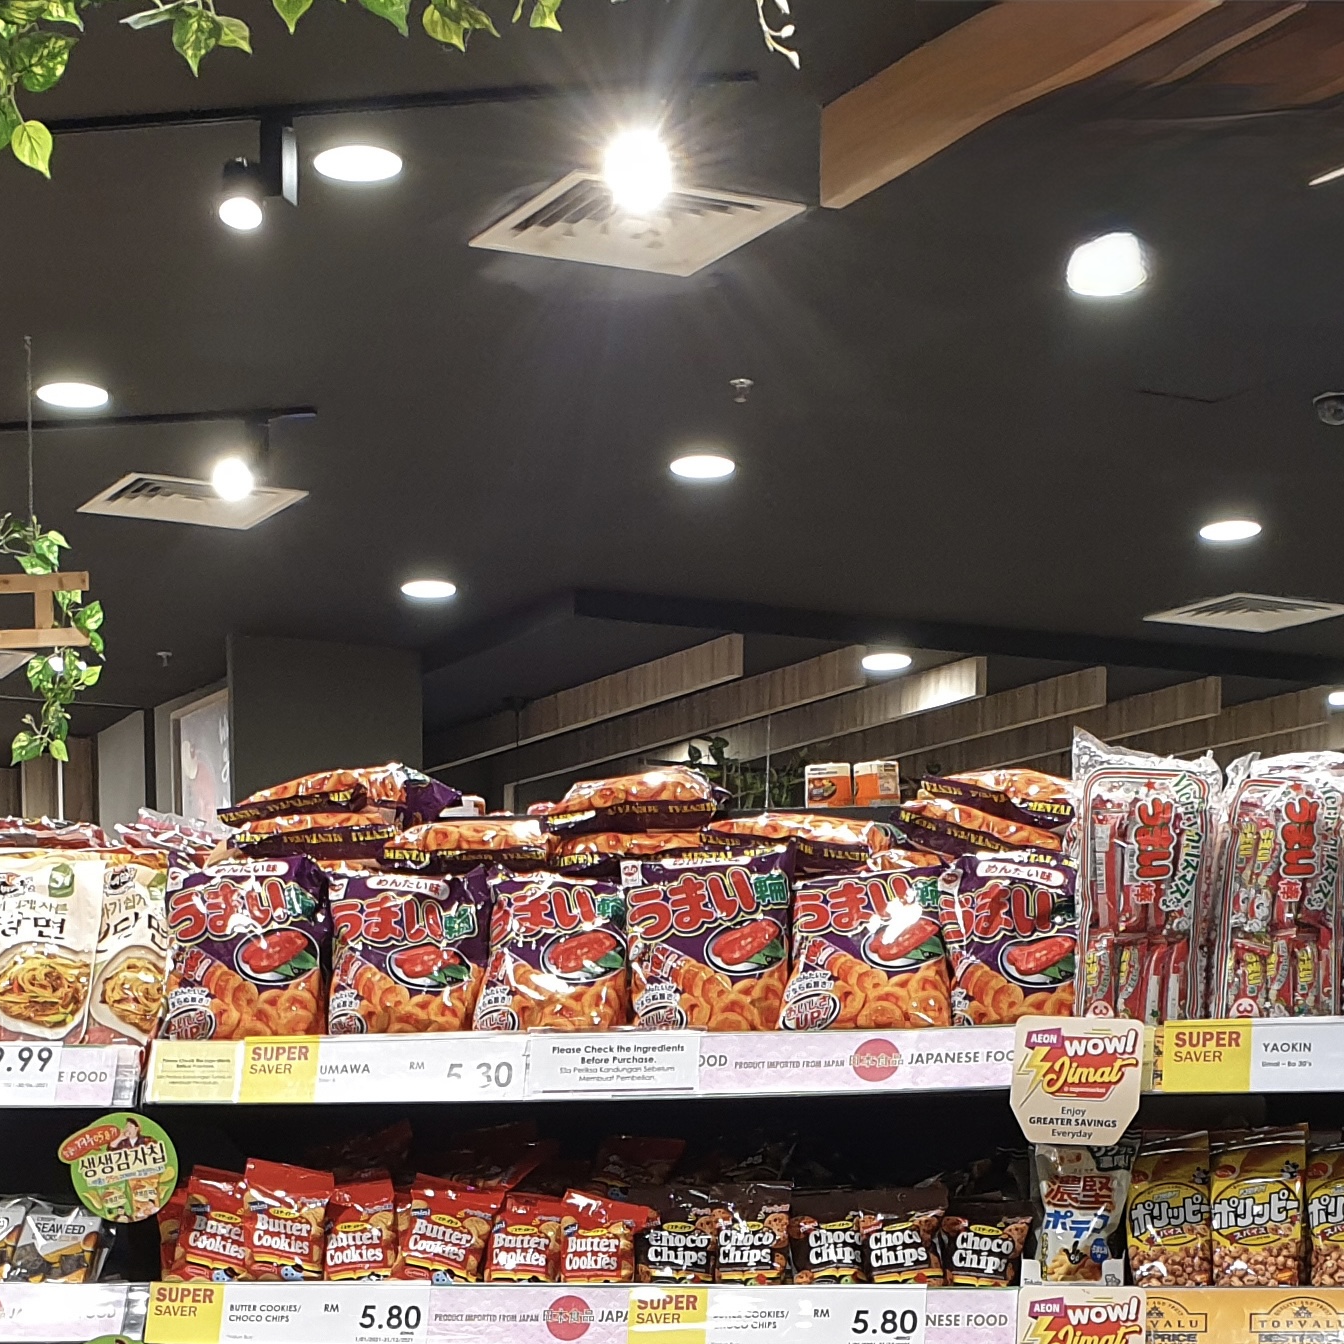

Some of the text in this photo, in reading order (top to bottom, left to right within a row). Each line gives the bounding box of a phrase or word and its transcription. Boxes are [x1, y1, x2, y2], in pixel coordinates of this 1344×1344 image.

[1030, 1033, 1058, 1045] AEON
[1064, 1029, 1137, 1056] WOW!
[1174, 1031, 1240, 1047] SUPER
[582, 1045, 612, 1055] Check
[1262, 1042, 1311, 1052] YAOKIN
[580, 1056, 607, 1065] Before
[908, 1052, 981, 1065] JAPANESE
[1173, 1051, 1222, 1063] SAVER
[320, 1064, 370, 1075] UMAWA
[409, 1061, 425, 1070] RM
[69, 1071, 107, 1083] FOOD
[1043, 1058, 1137, 1087] Jimat
[1060, 1106, 1087, 1118] Enjoy
[1029, 1117, 1117, 1128] GREATER SAVINGS
[1051, 1129, 1093, 1140] Everyday
[80, 1142, 165, 1178] 생생감자칩
[256, 1217, 311, 1237] Butter
[253, 1234, 310, 1255] Cookies
[870, 1230, 921, 1248] Choco
[956, 1233, 1013, 1253] Choco
[871, 1246, 927, 1267] Chips
[954, 1251, 1007, 1272] Chips
[156, 1287, 214, 1304] SUPER
[154, 1305, 197, 1317] SAVER
[229, 1304, 257, 1313] BUTTER
[324, 1303, 339, 1313] RM
[813, 1309, 830, 1318] RM
[262, 1315, 290, 1323] CHIPS
[359, 1305, 421, 1329] 5.80
[852, 1310, 918, 1335] 5.80
[965, 1314, 1008, 1327] FOOD
